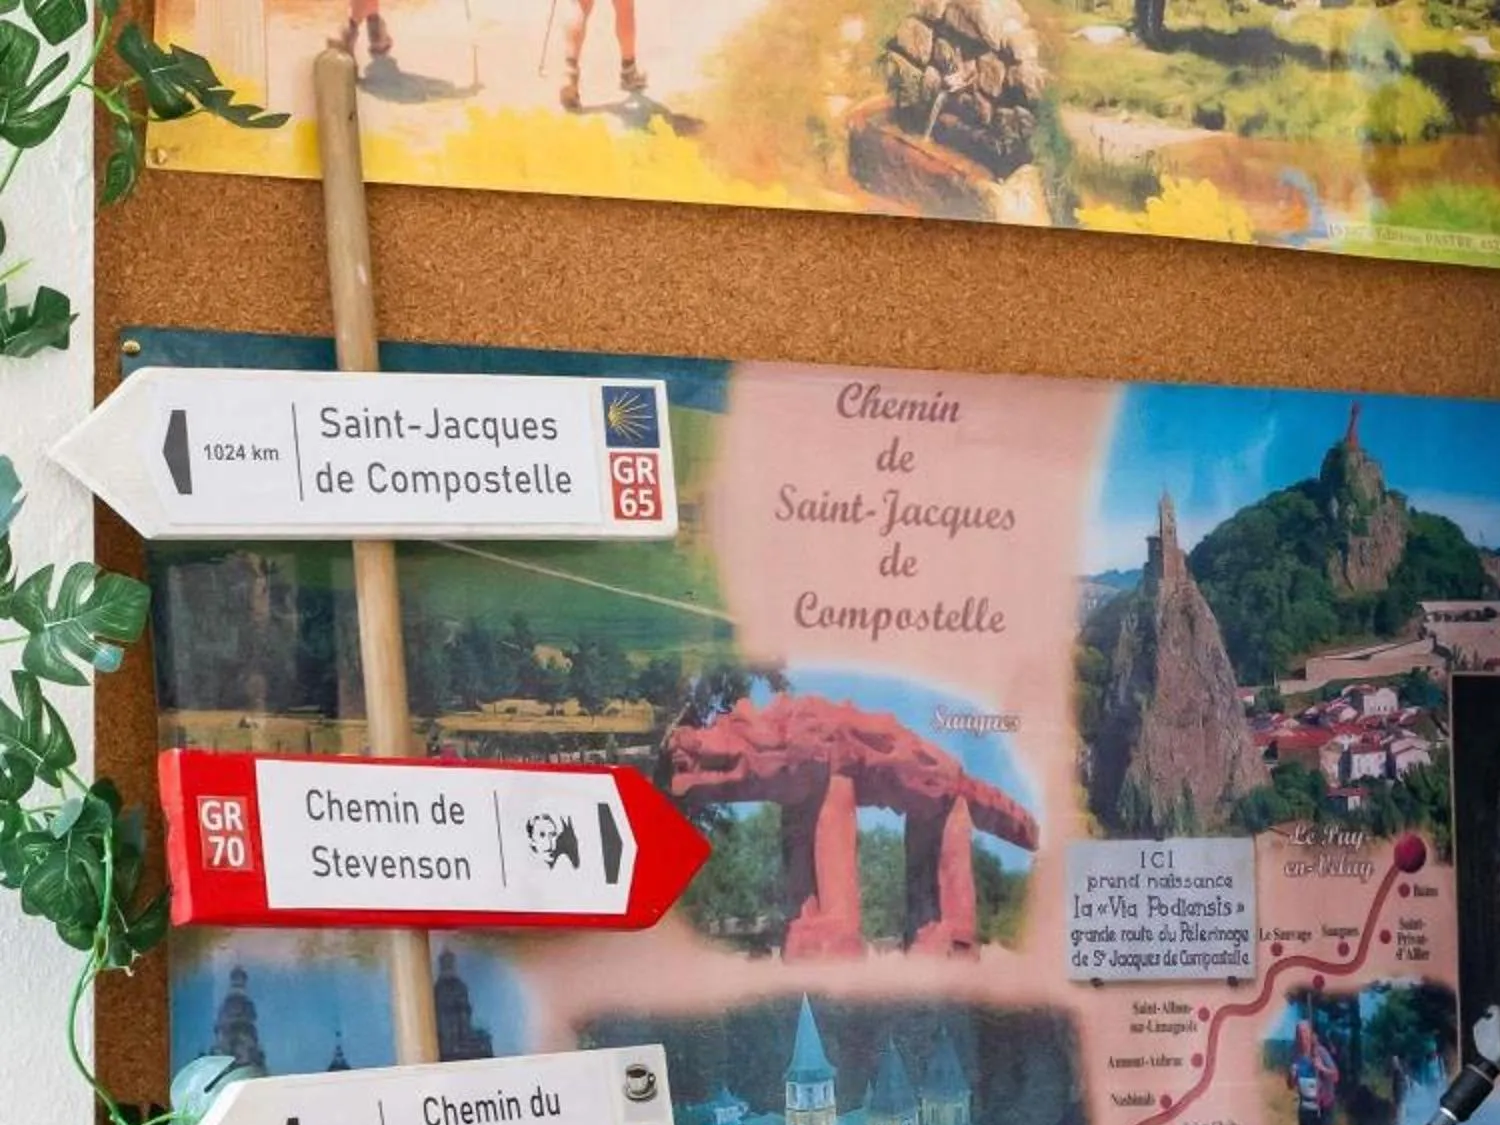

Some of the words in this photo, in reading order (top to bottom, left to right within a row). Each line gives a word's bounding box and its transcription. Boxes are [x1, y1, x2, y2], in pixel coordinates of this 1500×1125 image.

[836, 381, 961, 423] Chemin
[320, 407, 557, 449] Saint-Jacques
[203, 444, 246, 462] 1024
[252, 443, 279, 462] km
[876, 436, 916, 473] de
[316, 463, 354, 494] de
[367, 463, 572, 501] Compostelle
[612, 455, 656, 486] GR
[620, 488, 656, 518] 65
[775, 483, 1017, 540] Saint-Jacques
[879, 542, 919, 578] de
[794, 590, 1007, 641] Compostelle
[201, 800, 243, 832] GR
[305, 789, 420, 824] Chemin
[430, 791, 466, 826] de
[1289, 823, 1315, 845] Le
[208, 834, 245, 868] 70
[311, 848, 472, 882] Stevenson
[1140, 850, 1174, 869] ICI
[1087, 874, 1140, 892] prend
[1147, 873, 1233, 889] naissance
[1074, 894, 1093, 919] la
[1071, 925, 1117, 947] grande
[1120, 926, 1153, 942] route
[1159, 924, 1177, 943] du
[1260, 928, 1272, 942] Le
[1071, 951, 1089, 967] de
[1109, 951, 1160, 972] Jacques
[1163, 950, 1178, 966] de
[531, 1086, 561, 1118] du
